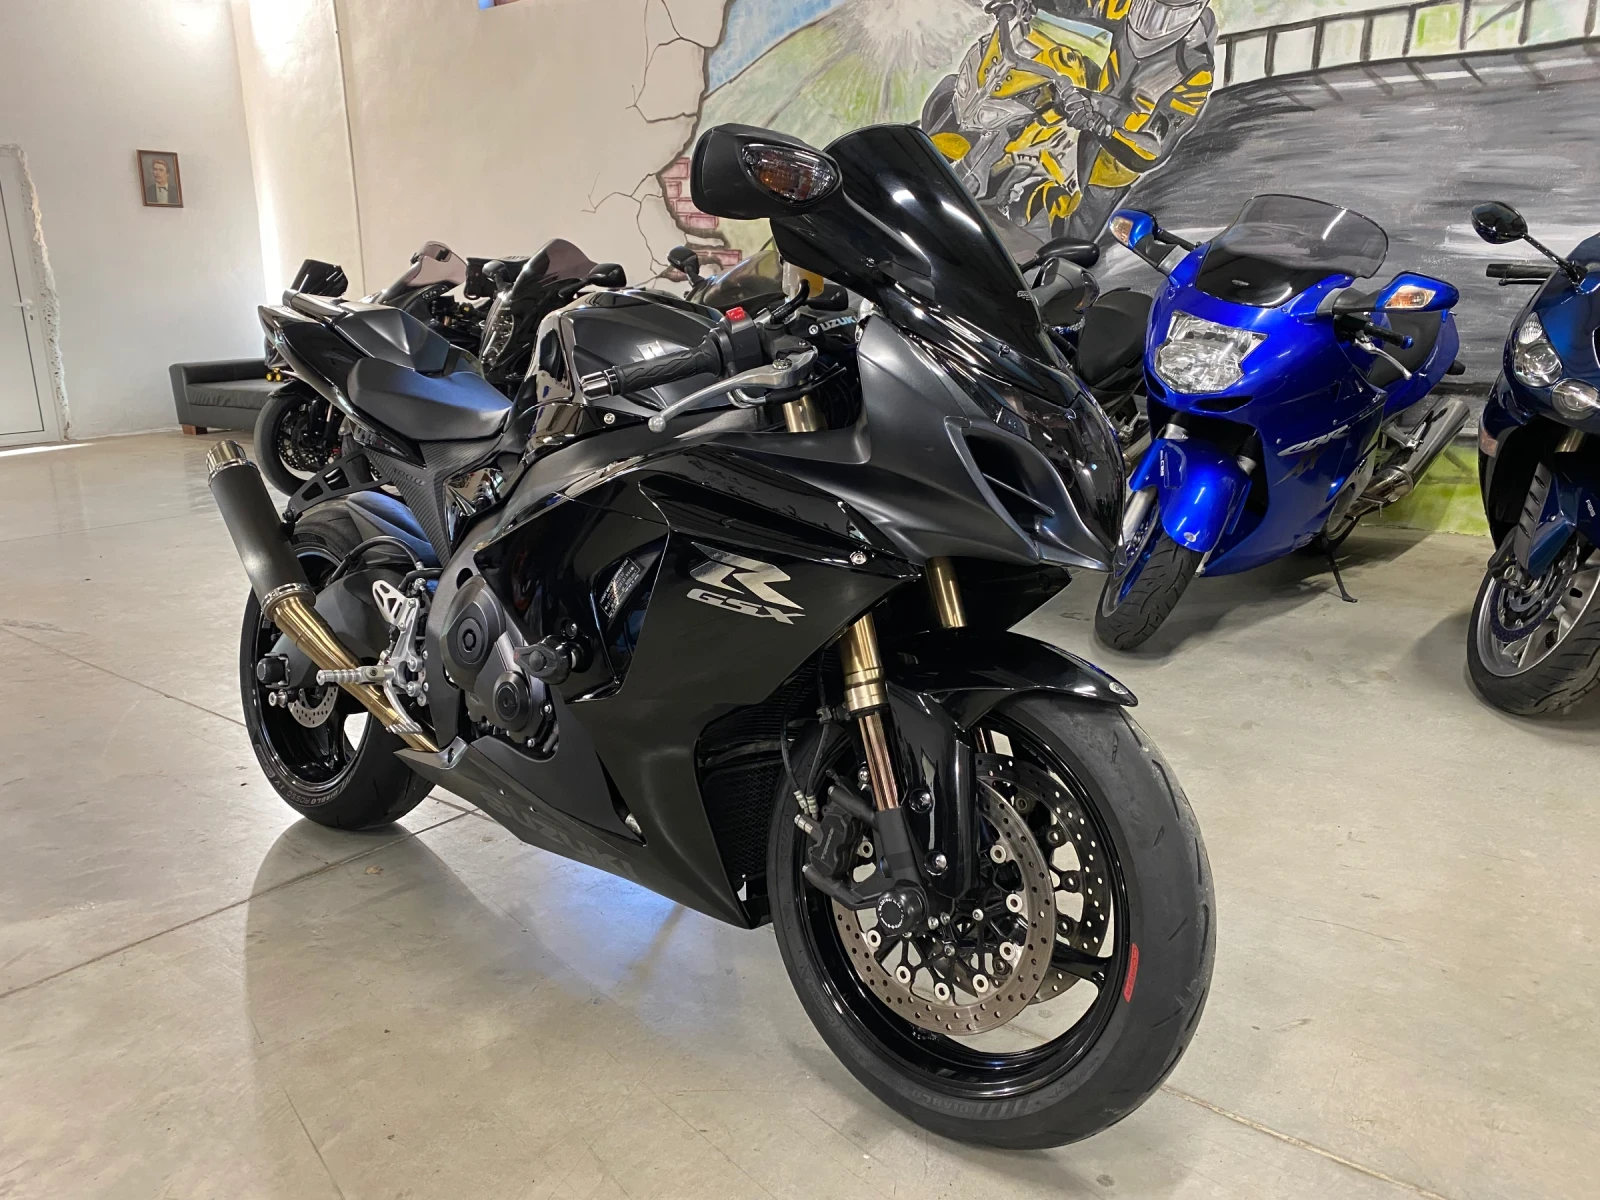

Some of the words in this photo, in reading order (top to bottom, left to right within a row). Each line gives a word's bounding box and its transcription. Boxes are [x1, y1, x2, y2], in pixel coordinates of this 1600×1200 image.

[819, 316, 858, 331] UZUK
[1277, 423, 1350, 457] CBR
[686, 588, 807, 625] GSX
